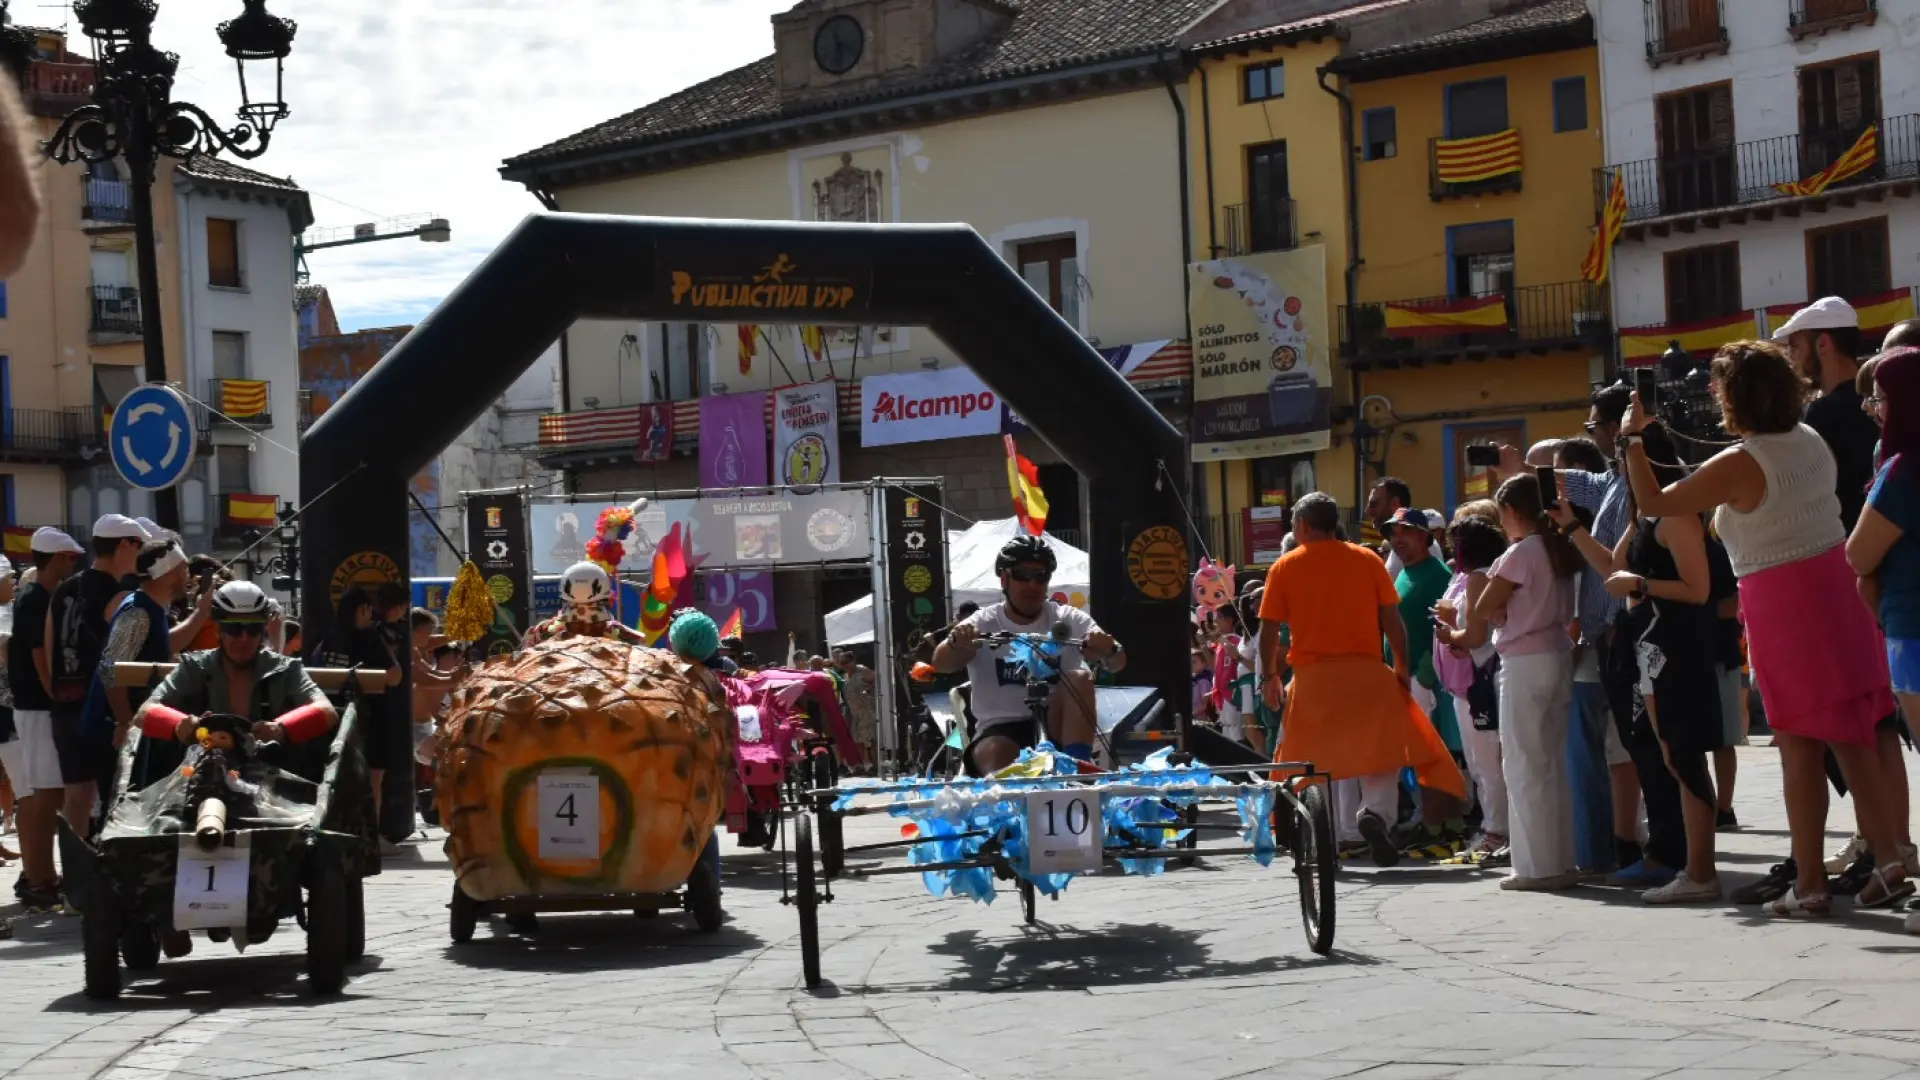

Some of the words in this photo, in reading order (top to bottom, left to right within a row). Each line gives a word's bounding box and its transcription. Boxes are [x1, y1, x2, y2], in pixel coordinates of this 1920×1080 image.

[671, 270, 808, 308] PUBLIACTIVA
[1199, 331, 1260, 349] ALIMENTOS
[1201, 357, 1261, 379] MARRÓN
[872, 391, 995, 423] Alcampo
[555, 793, 579, 827] 4
[1044, 798, 1089, 836] 10
[203, 865, 216, 892] 1
